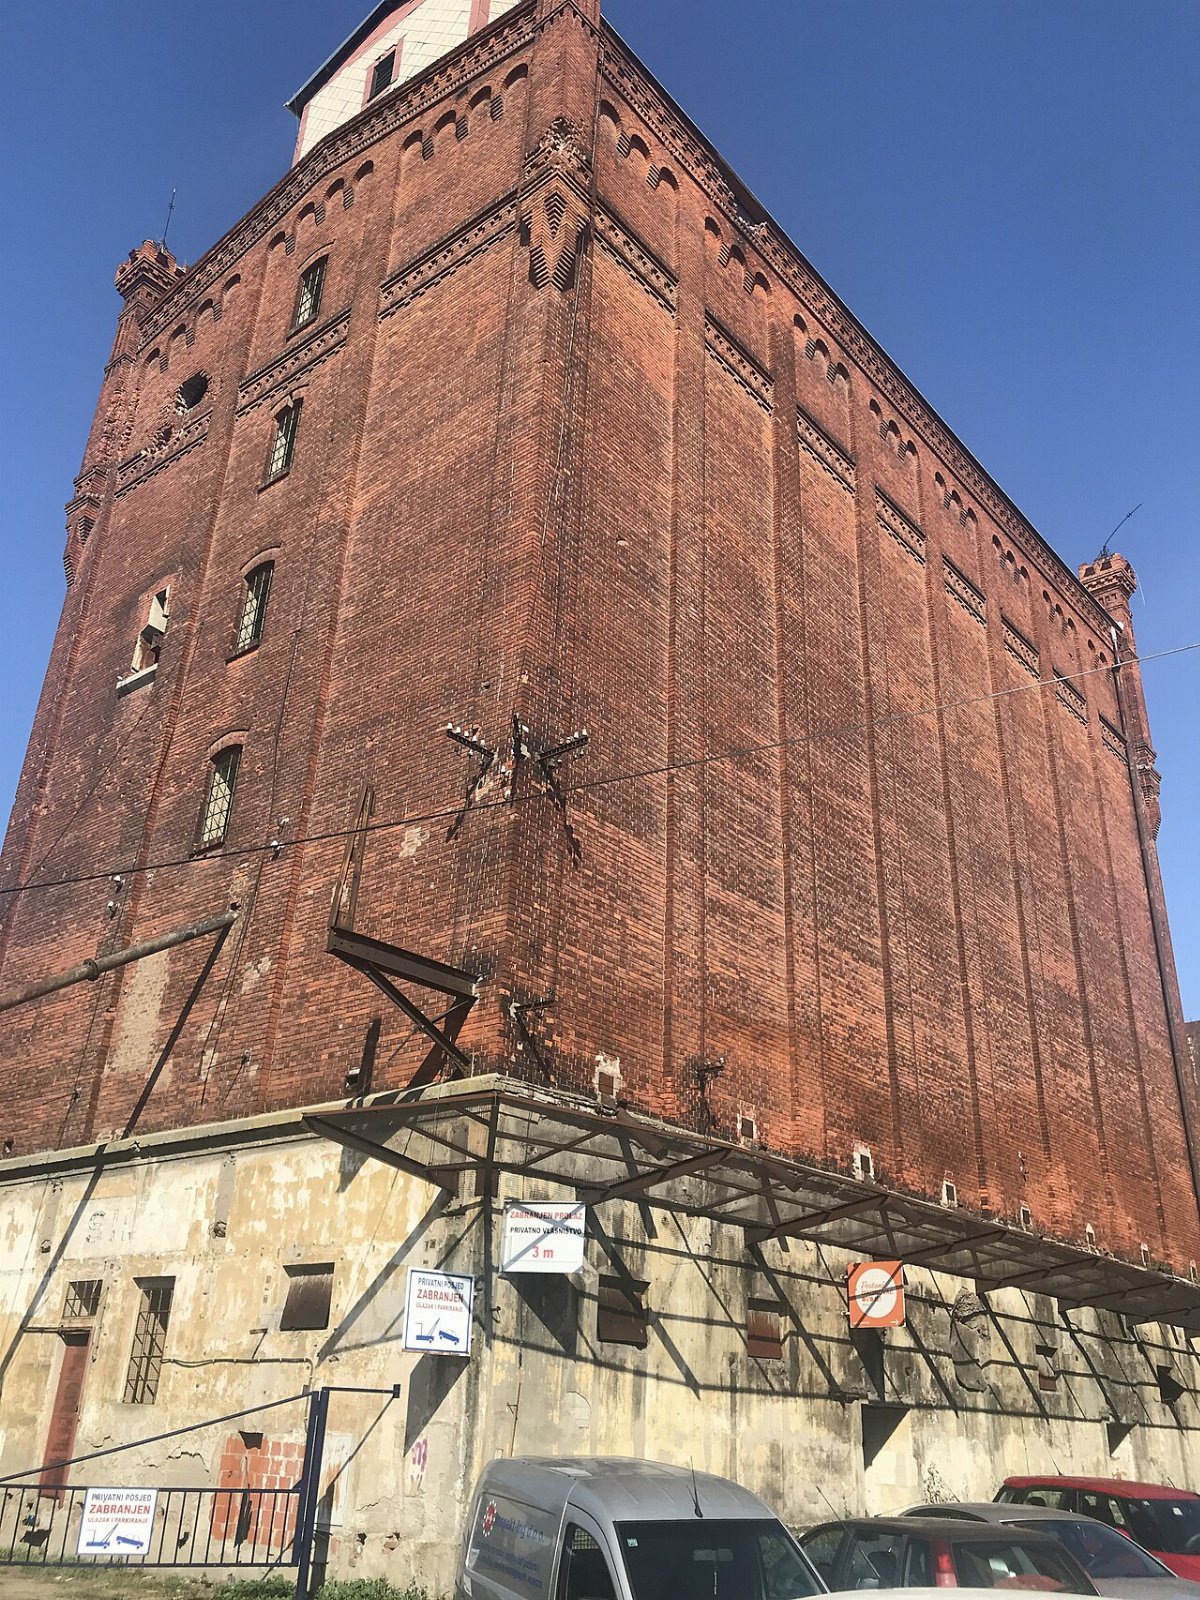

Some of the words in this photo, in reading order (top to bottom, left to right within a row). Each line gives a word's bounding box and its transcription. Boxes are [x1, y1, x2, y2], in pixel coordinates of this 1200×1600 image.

[510, 1211, 552, 1220] ZABRANJEN
[554, 1212, 583, 1220] PROLAZ
[510, 1226, 541, 1234] PRIVATNO
[532, 1245, 539, 1258] 3
[543, 1248, 554, 1258] m
[418, 1277, 444, 1288] PRIVATNI
[444, 1280, 465, 1290] POSJED
[417, 1289, 464, 1303] ZABRANJEN
[92, 1493, 124, 1501] PRIVATNI
[125, 1494, 152, 1502] POSJED
[89, 1504, 151, 1514] ZABRANJEN
